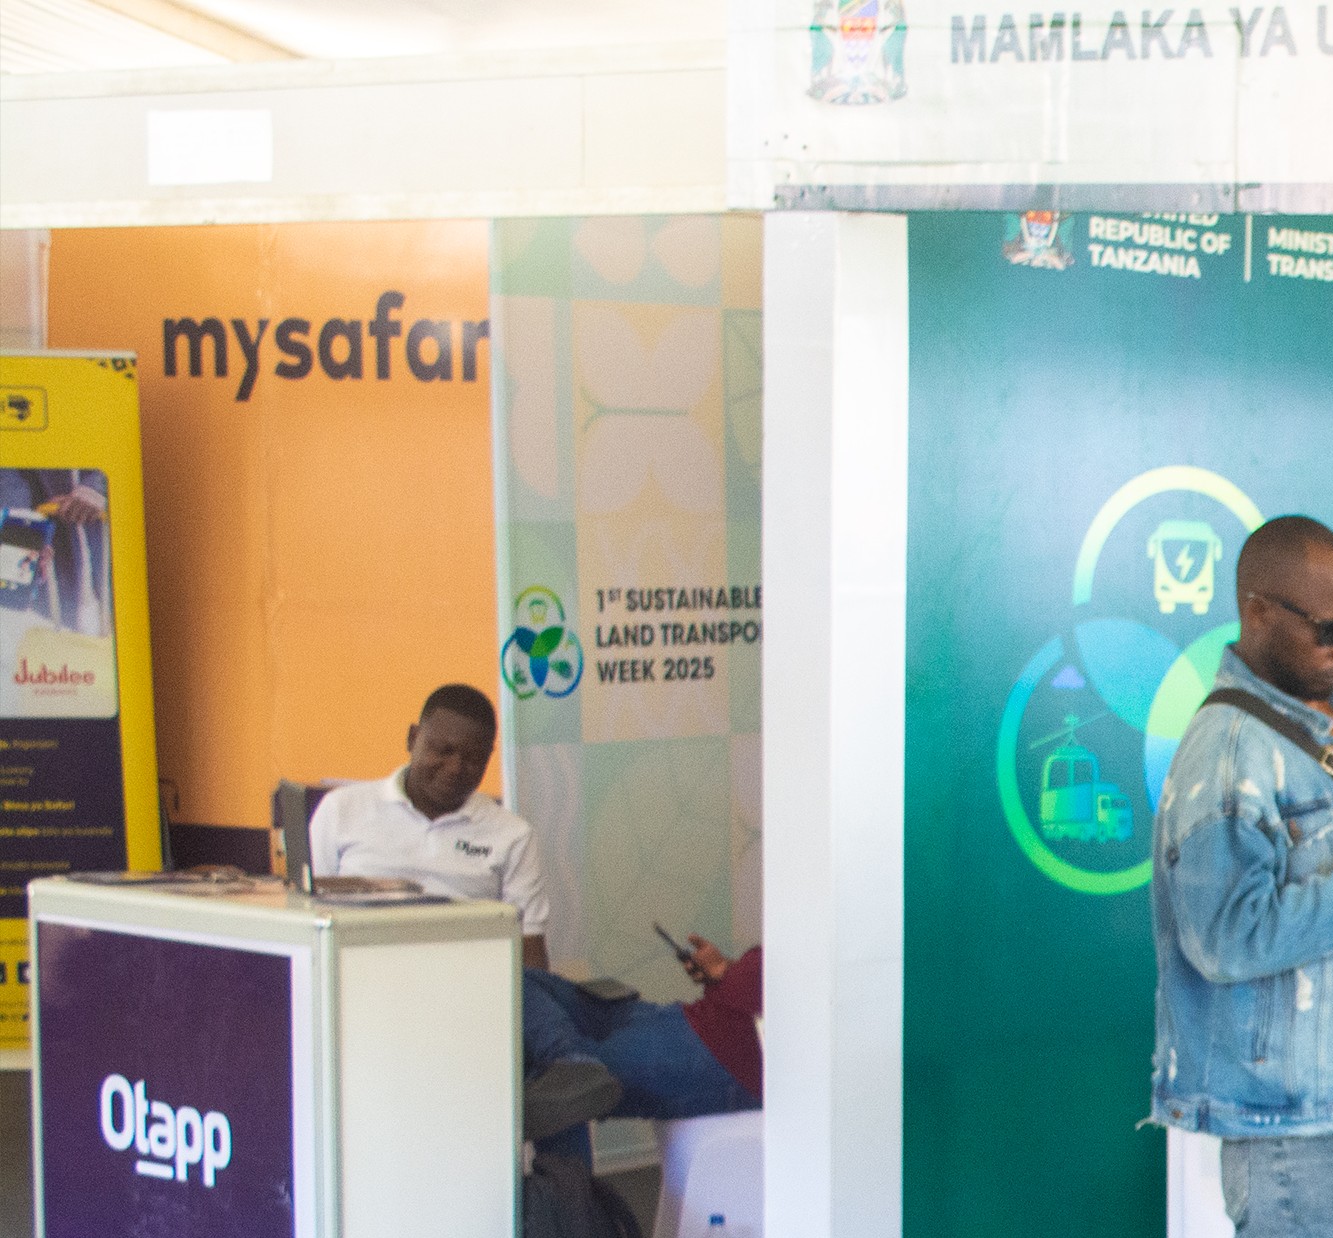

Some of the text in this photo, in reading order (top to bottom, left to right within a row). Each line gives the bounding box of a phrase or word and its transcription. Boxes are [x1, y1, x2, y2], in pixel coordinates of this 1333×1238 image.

[950, 8, 1213, 64] MAMLAKA
[1229, 4, 1298, 58] YA
[1089, 217, 1198, 254] REPUBLIC
[1200, 230, 1232, 256] OF
[1088, 244, 1202, 279] TANZANIA
[595, 620, 762, 648] LAND TRANSPO
[14, 656, 96, 685] Jubilee
[597, 655, 716, 683] WEEK 2025
[99, 1072, 232, 1188] Otapp
